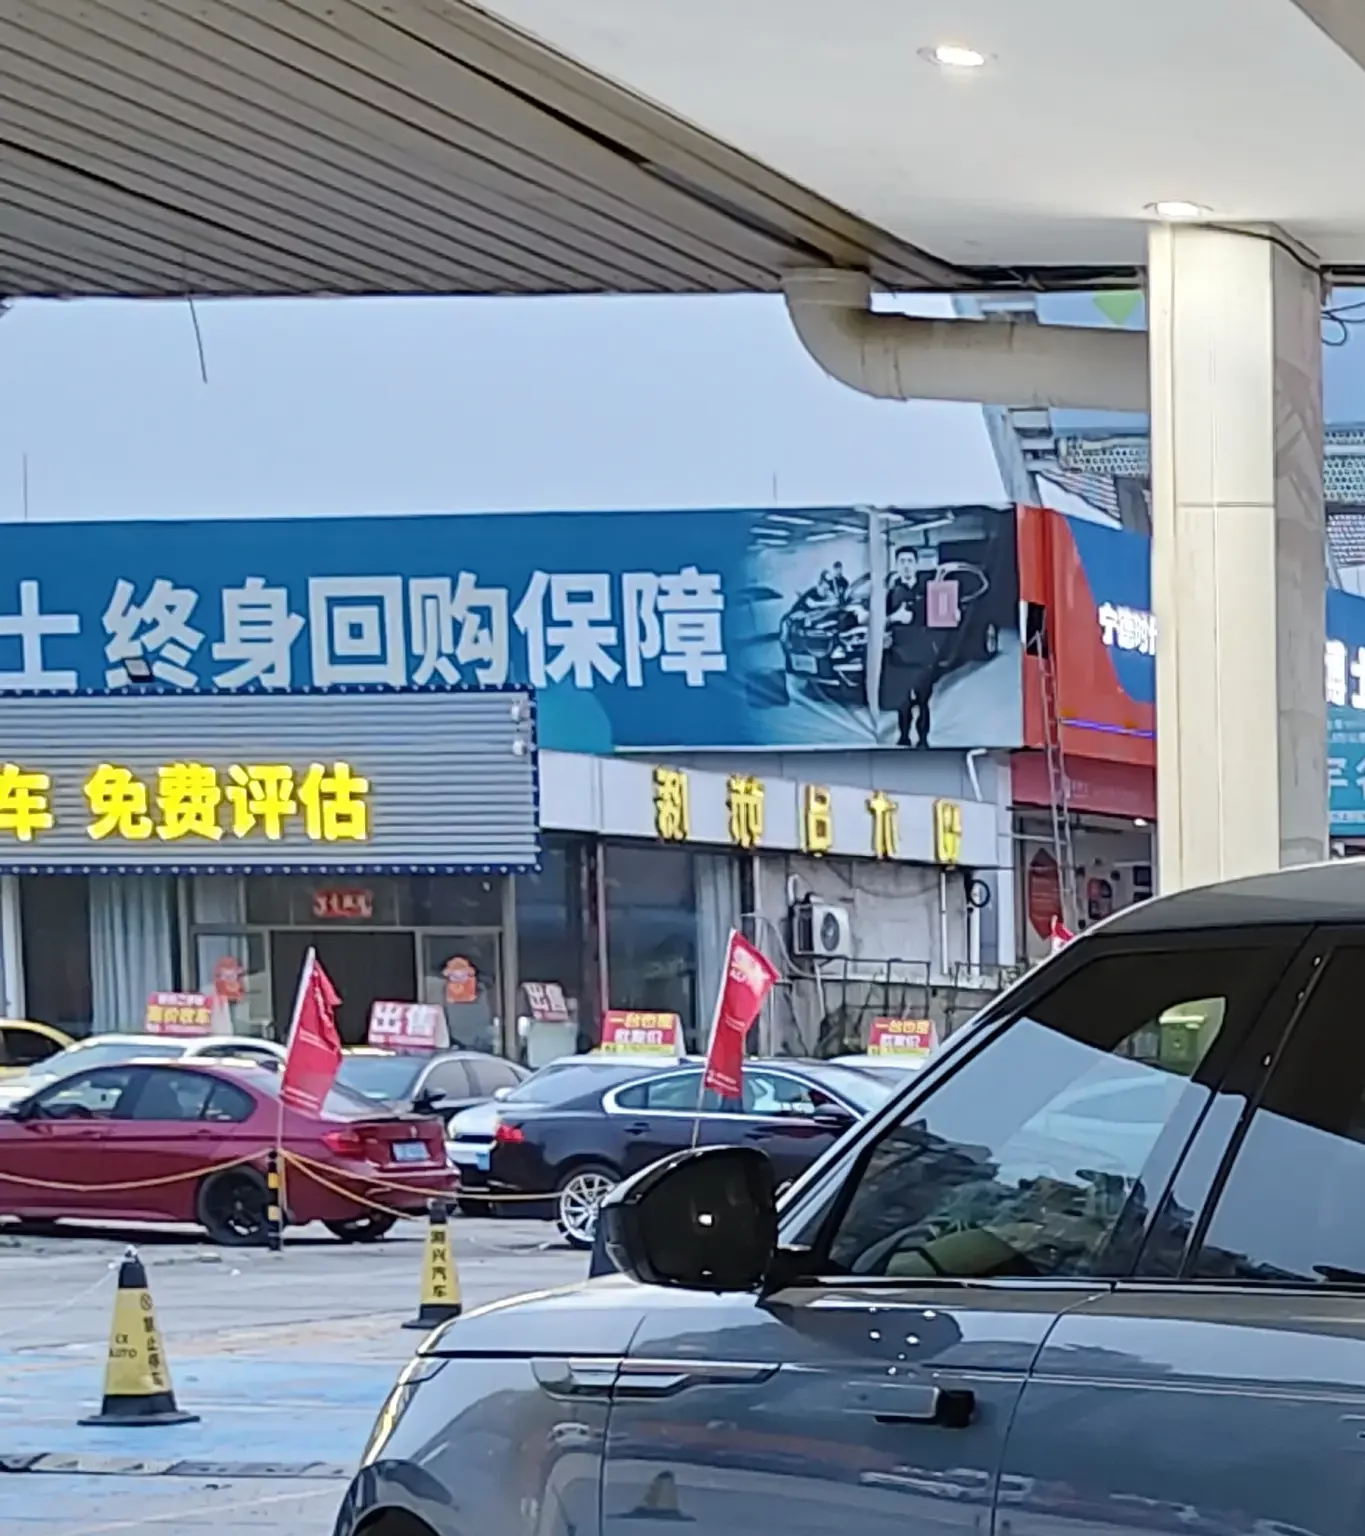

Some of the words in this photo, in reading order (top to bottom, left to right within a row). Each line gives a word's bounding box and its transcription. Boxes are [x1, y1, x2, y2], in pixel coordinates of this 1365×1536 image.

[102, 565, 728, 689] 终身回购保障
[0, 763, 52, 841] 车
[84, 762, 370, 841] 免费评估
[370, 1002, 437, 1037] 出售
